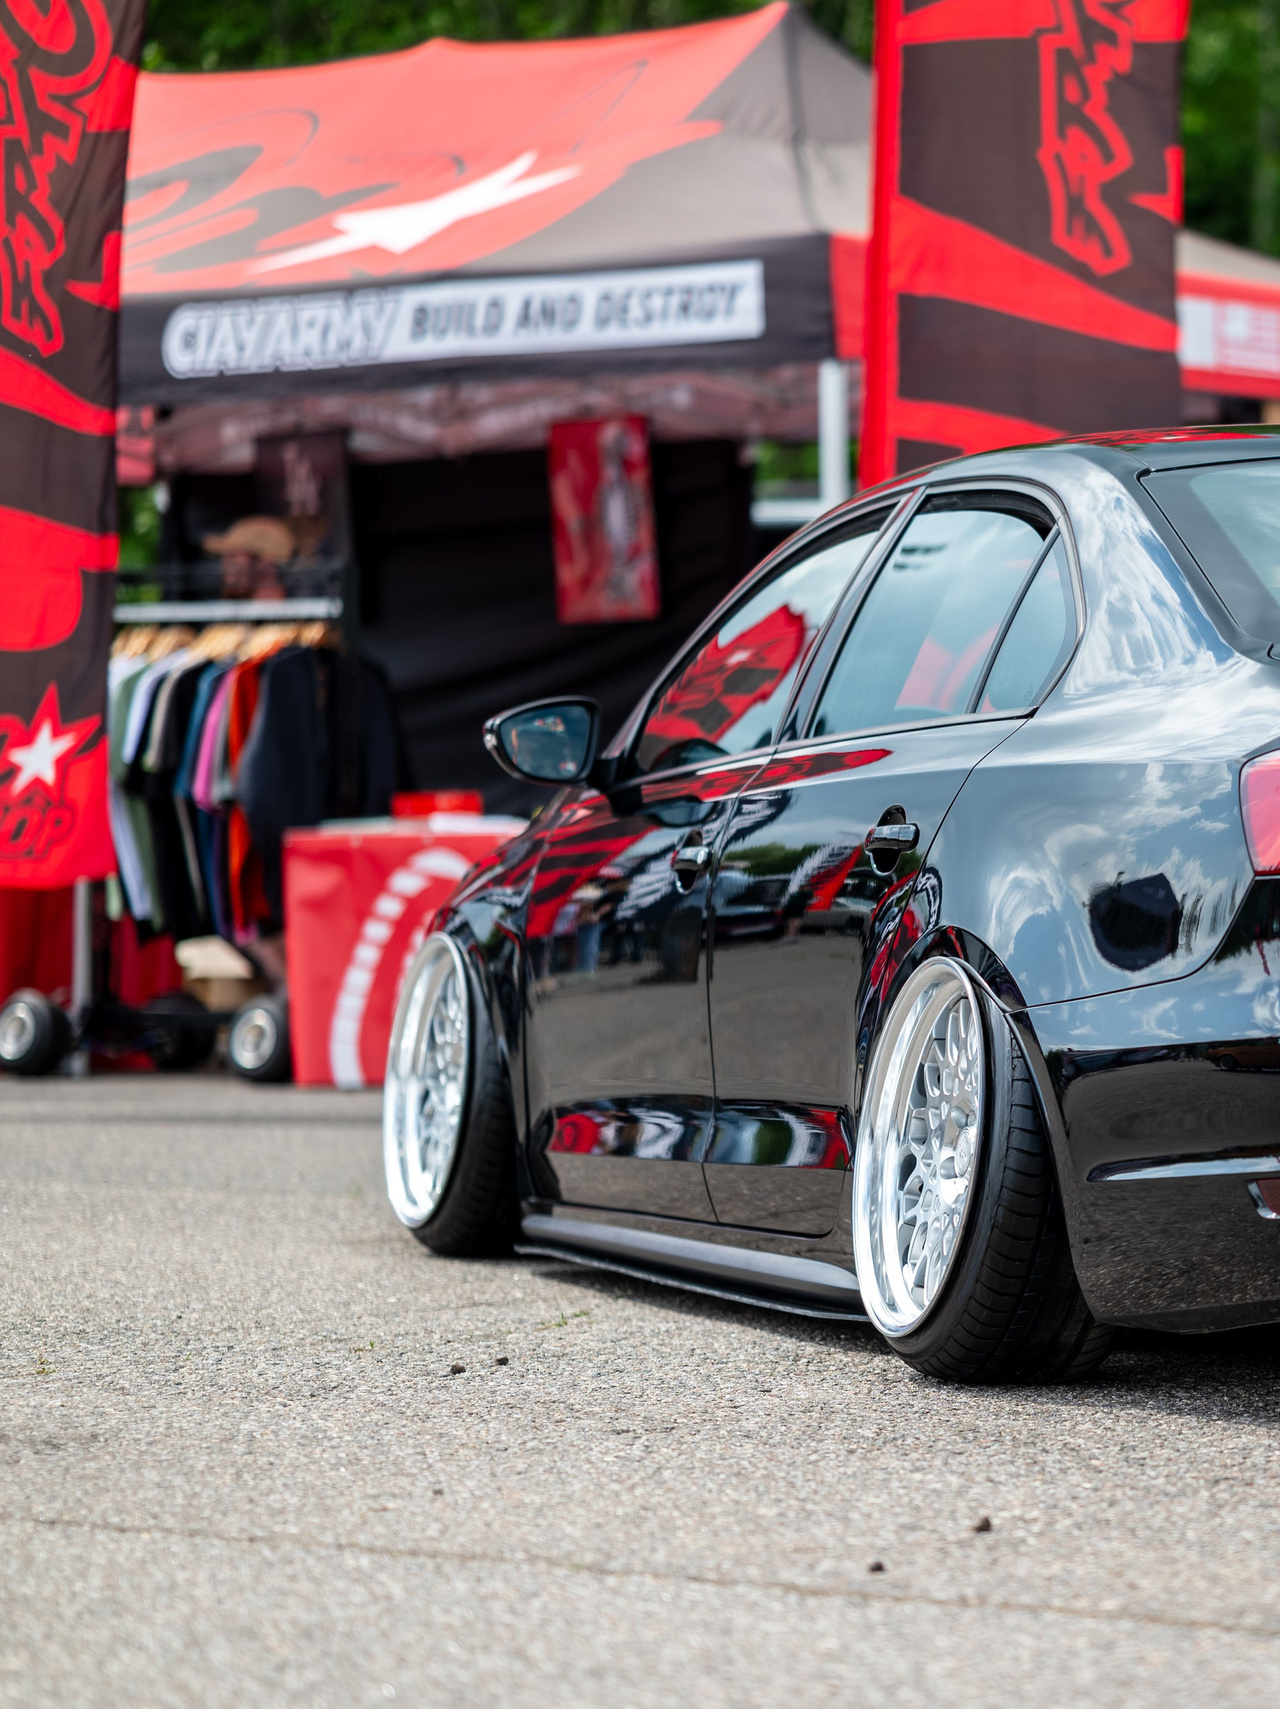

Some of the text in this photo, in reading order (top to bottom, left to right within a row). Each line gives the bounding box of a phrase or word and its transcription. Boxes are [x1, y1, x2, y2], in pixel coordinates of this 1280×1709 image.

[409, 301, 503, 343] BUILD
[514, 291, 586, 336] AND
[594, 281, 746, 330] DESTROY
